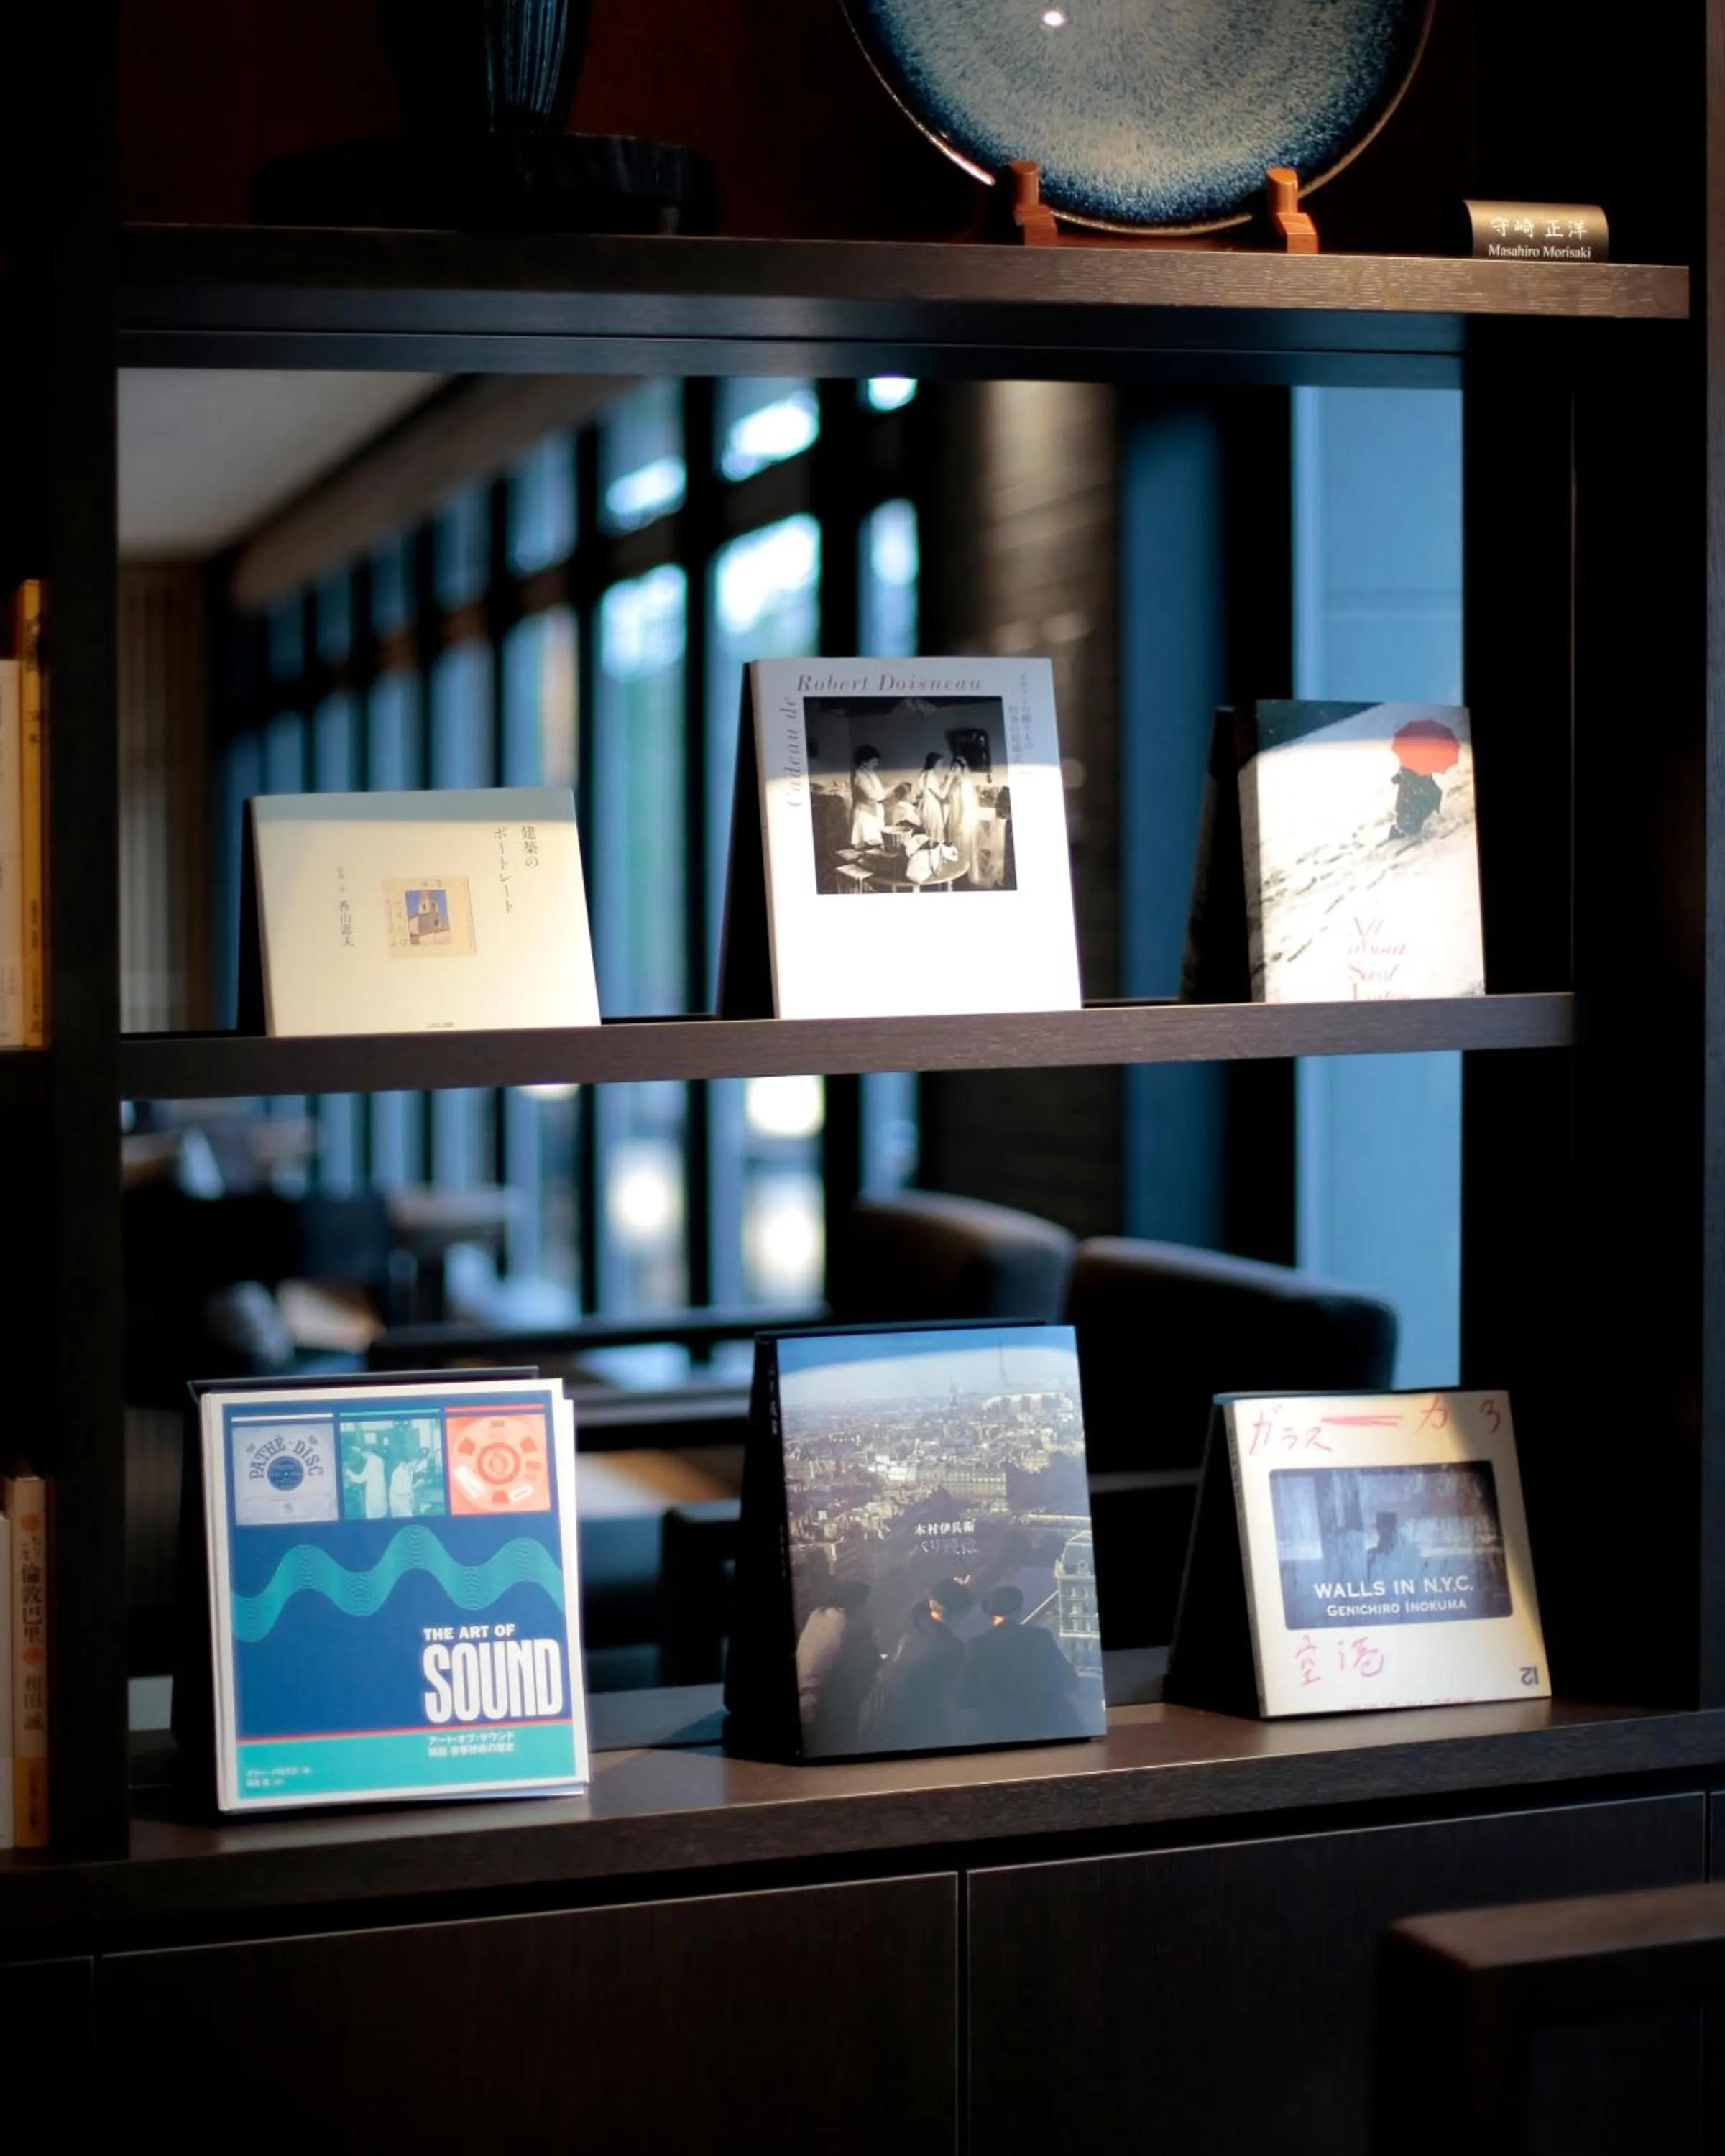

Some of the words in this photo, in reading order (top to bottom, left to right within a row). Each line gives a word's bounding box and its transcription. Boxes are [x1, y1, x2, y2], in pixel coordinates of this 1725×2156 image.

[1488, 244, 1540, 257] Masahiro
[1542, 245, 1592, 259] Morisaki
[796, 673, 869, 692] Robert
[878, 673, 982, 691] Doisneau
[293, 1439, 324, 1476] DISC
[1313, 1580, 1386, 1600] WALLS
[1393, 1577, 1416, 1595] IN
[1423, 1575, 1475, 1593] N.Y.C.
[1404, 1598, 1468, 1613] INOKUMA
[423, 1627, 454, 1641] THE
[459, 1625, 489, 1639] ART
[494, 1623, 515, 1636] OF
[423, 1638, 563, 1723] SOUND
